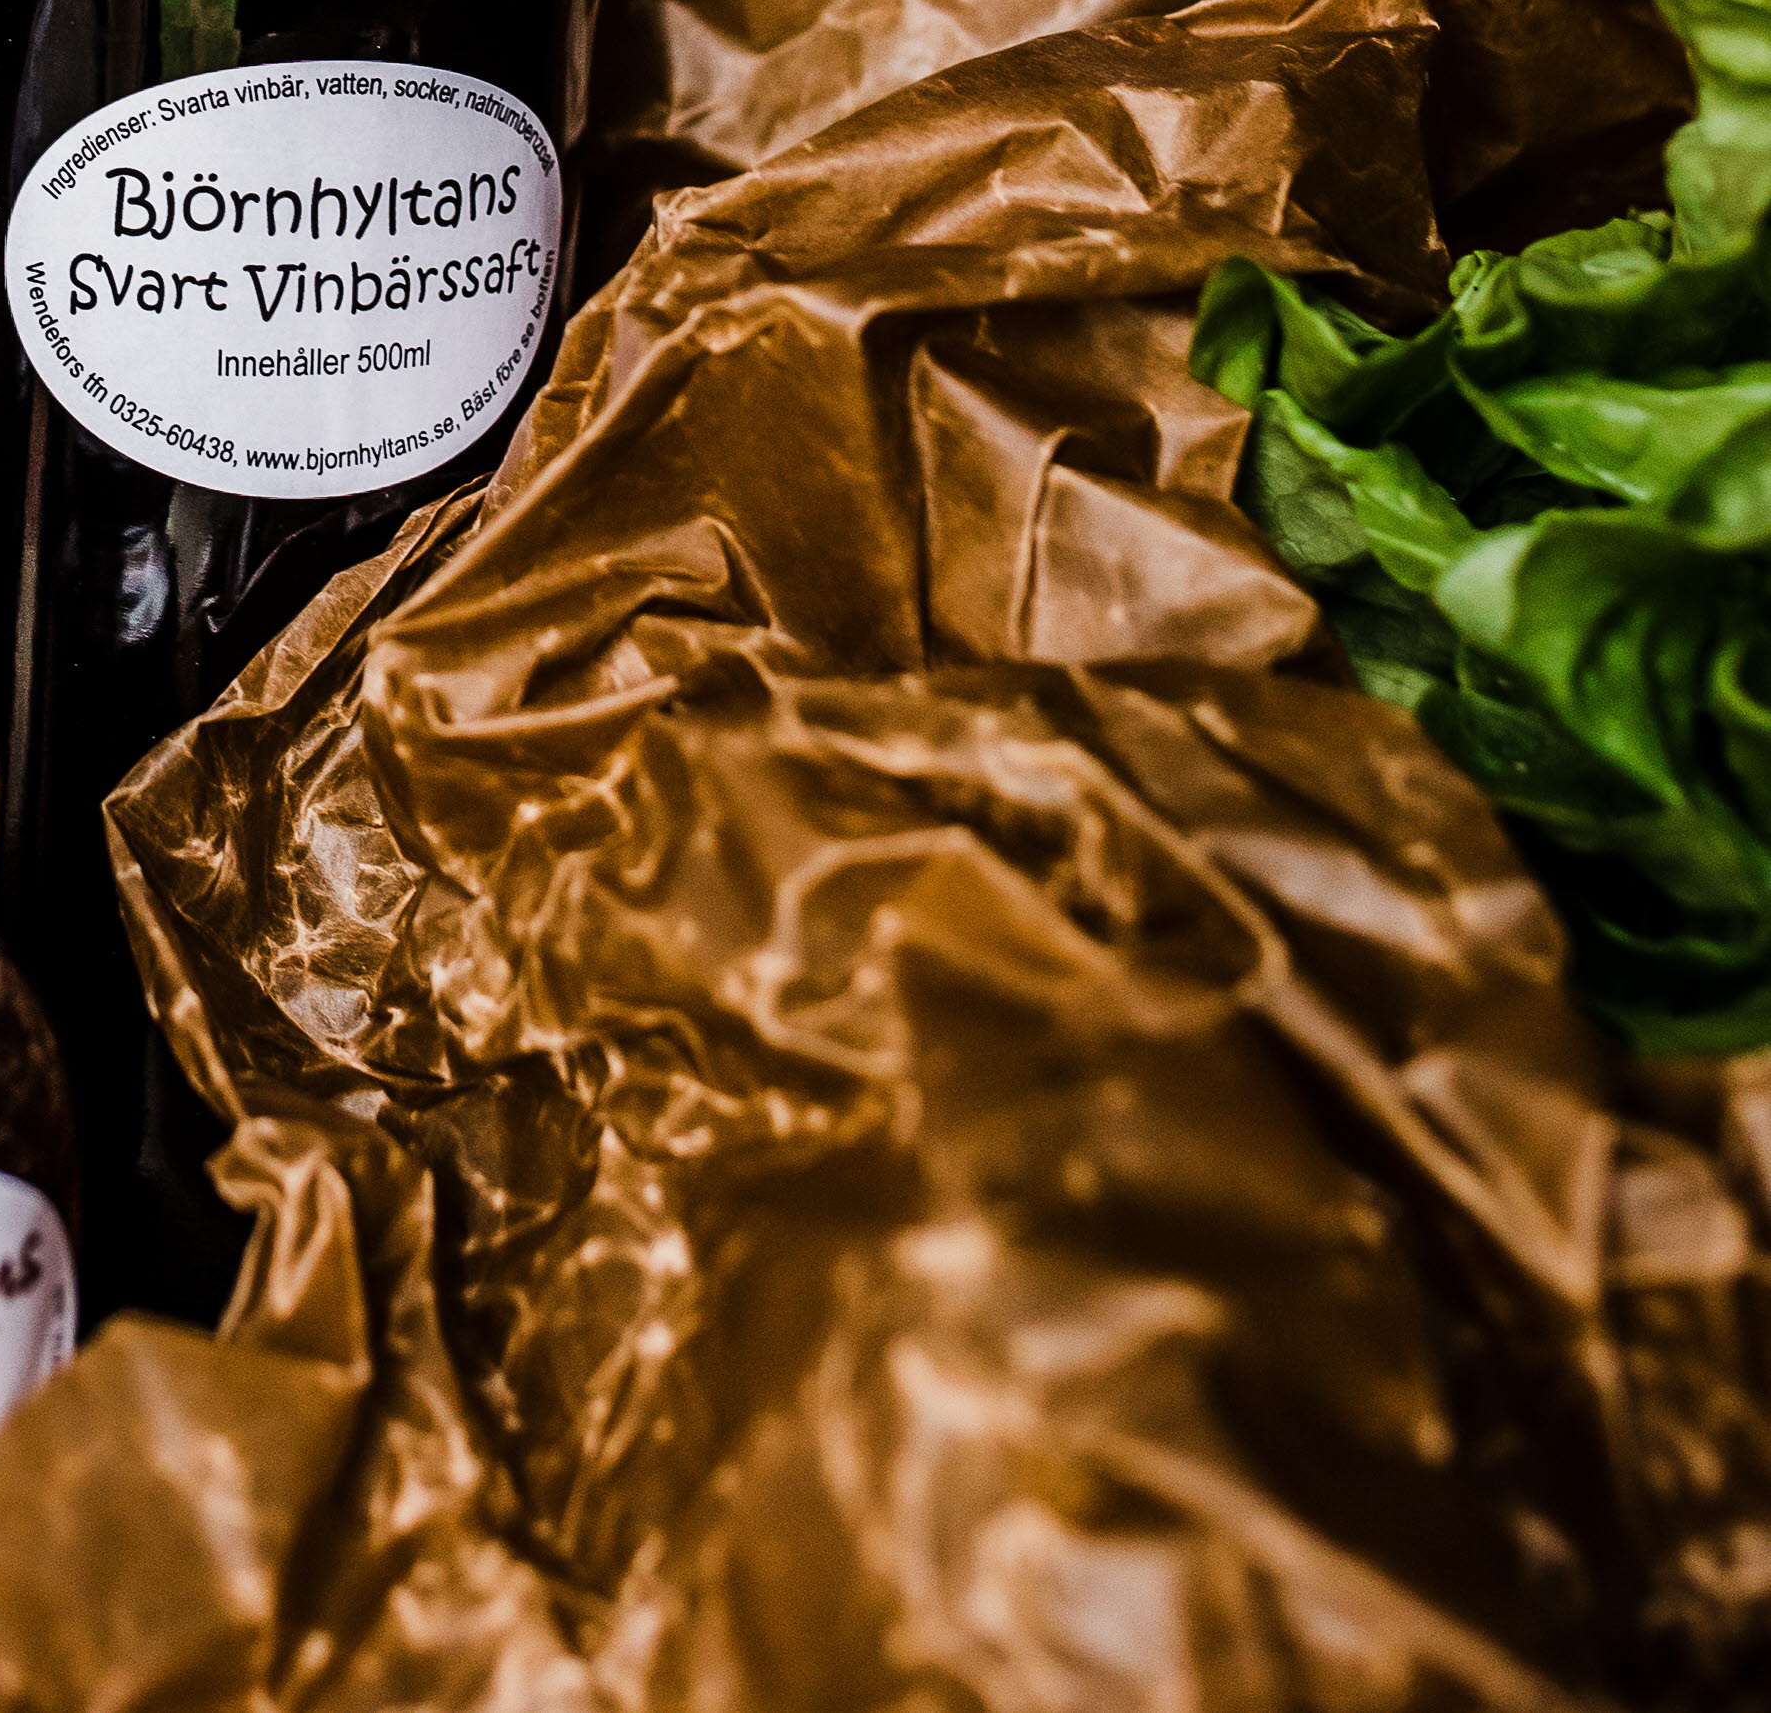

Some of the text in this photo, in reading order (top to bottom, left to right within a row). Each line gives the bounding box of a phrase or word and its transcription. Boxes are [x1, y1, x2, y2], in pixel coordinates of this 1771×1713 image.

[41, 109, 157, 200] Ingredienser:
[157, 87, 229, 121] Svarta
[234, 74, 310, 104] vinbär,
[316, 72, 388, 99] vatten,
[393, 78, 460, 109] socker,
[105, 164, 521, 240] Björnhyltans
[69, 237, 541, 323] Svart Vinbärssaft
[25, 261, 85, 379] Wendefors
[82, 372, 108, 403] tfn
[109, 393, 238, 468] 0325-60438,
[246, 416, 461, 475] www.bjornhyltans.se,
[460, 379, 497, 421] Bäst
[495, 348, 522, 386] före
[520, 321, 535, 349] se
[217, 338, 431, 377] Innehåller 500ml
